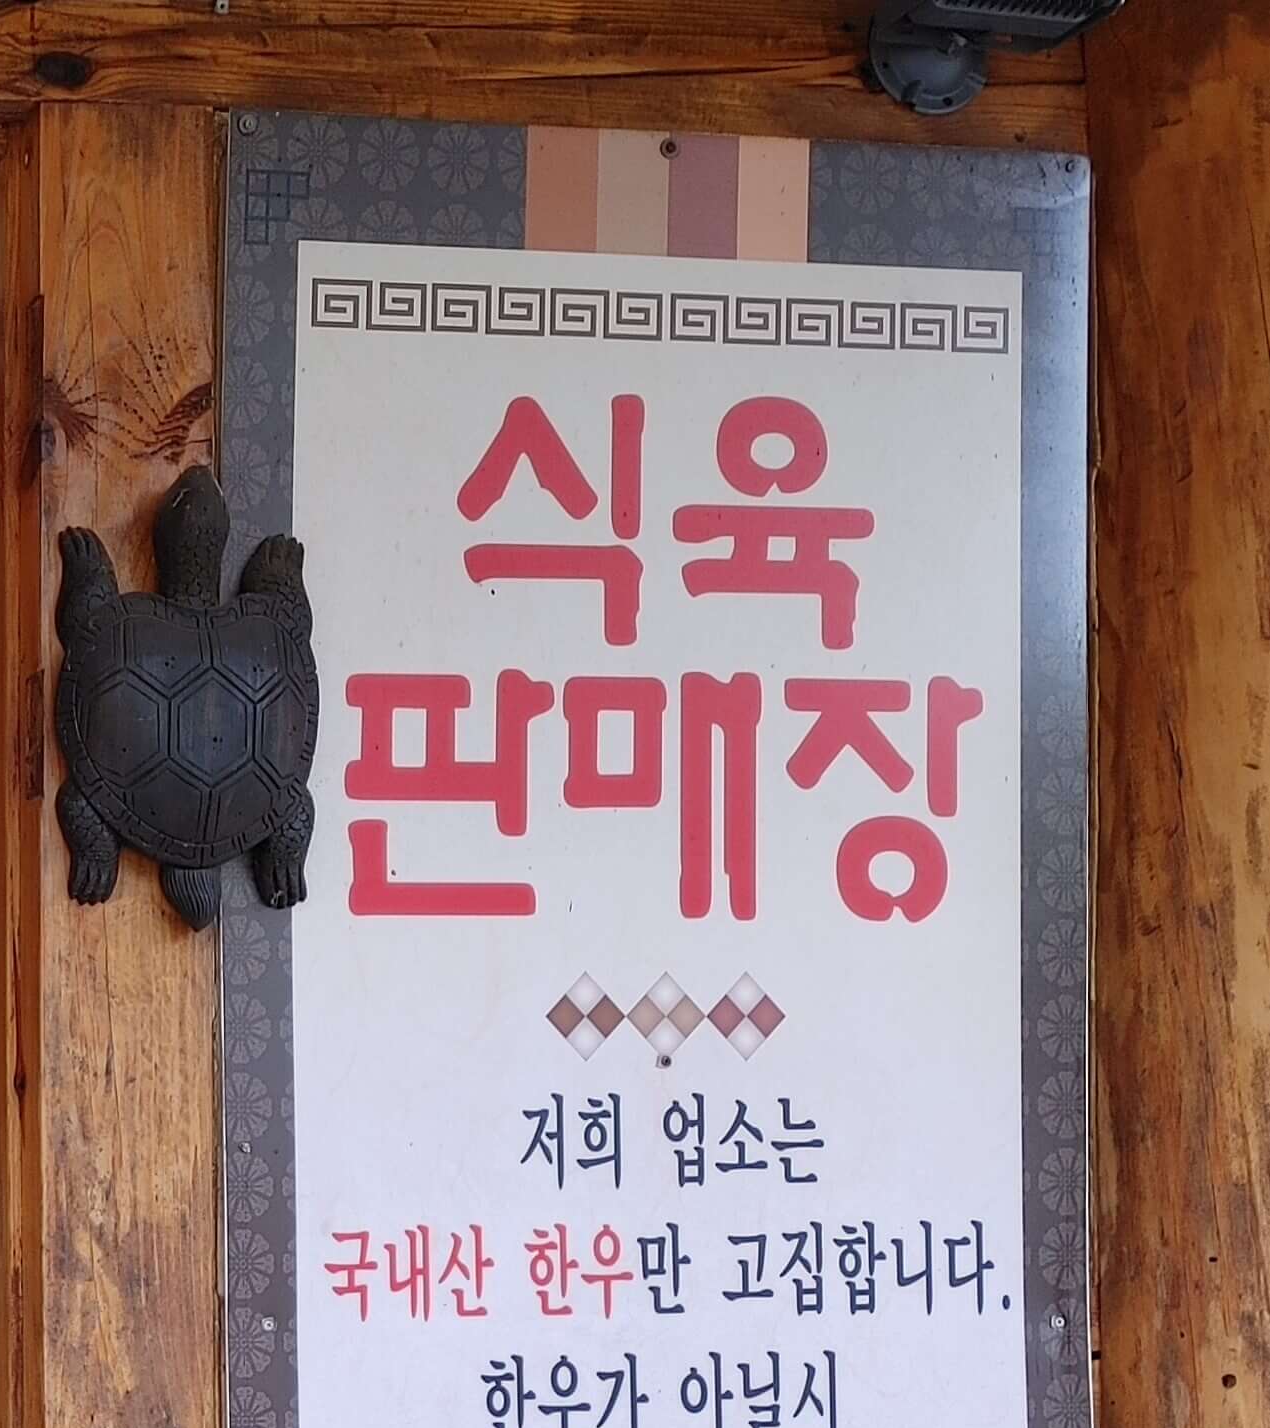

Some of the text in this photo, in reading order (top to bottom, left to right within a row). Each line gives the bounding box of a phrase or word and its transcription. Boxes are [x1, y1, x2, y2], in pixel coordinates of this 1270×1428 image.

[457, 394, 875, 650] 식육
[344, 668, 983, 923] 판매장
[520, 1092, 825, 1189] 저희 업소는
[324, 1219, 1011, 1322] 국내산 한우만 고집합니다.
